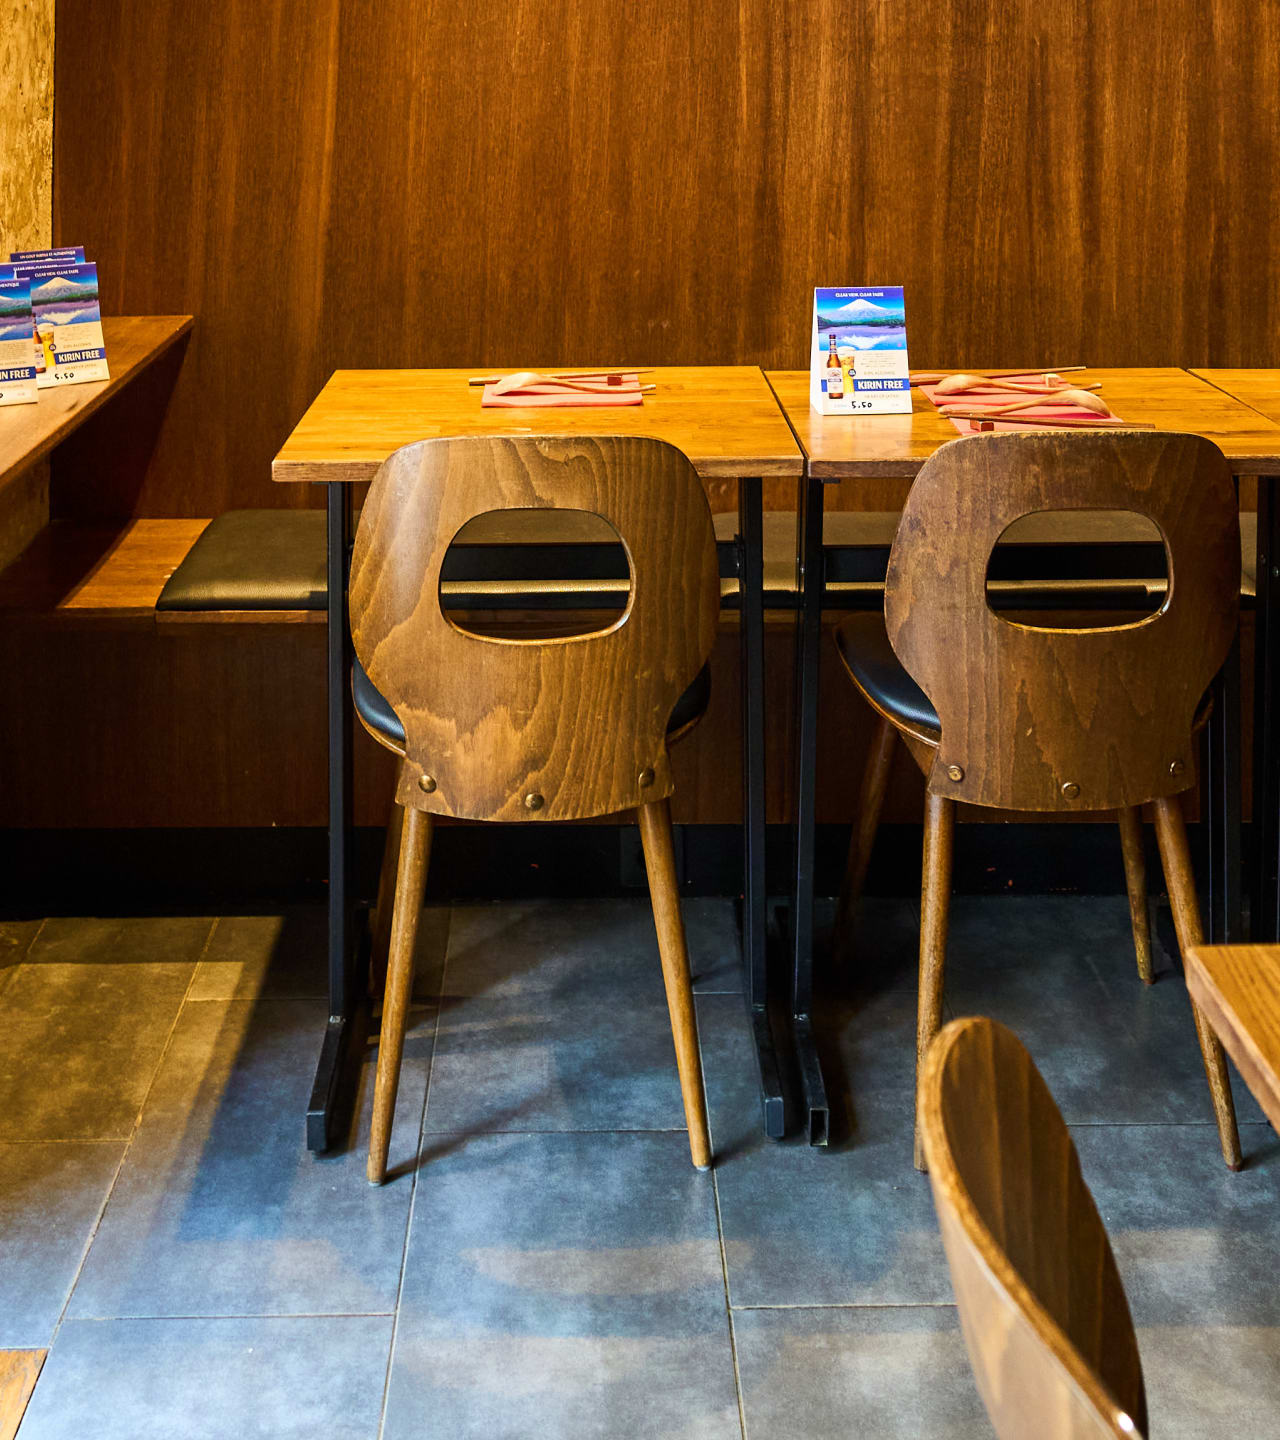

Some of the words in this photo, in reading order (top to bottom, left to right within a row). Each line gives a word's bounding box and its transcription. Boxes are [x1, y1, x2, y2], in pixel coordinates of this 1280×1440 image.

[58, 352, 81, 363] KIRIN
[81, 349, 101, 360] FREE
[9, 368, 31, 380] FREE
[54, 372, 75, 381] 5.50
[857, 380, 882, 390] KIRIN
[883, 380, 904, 389] FREE
[851, 400, 873, 409] 5.50
